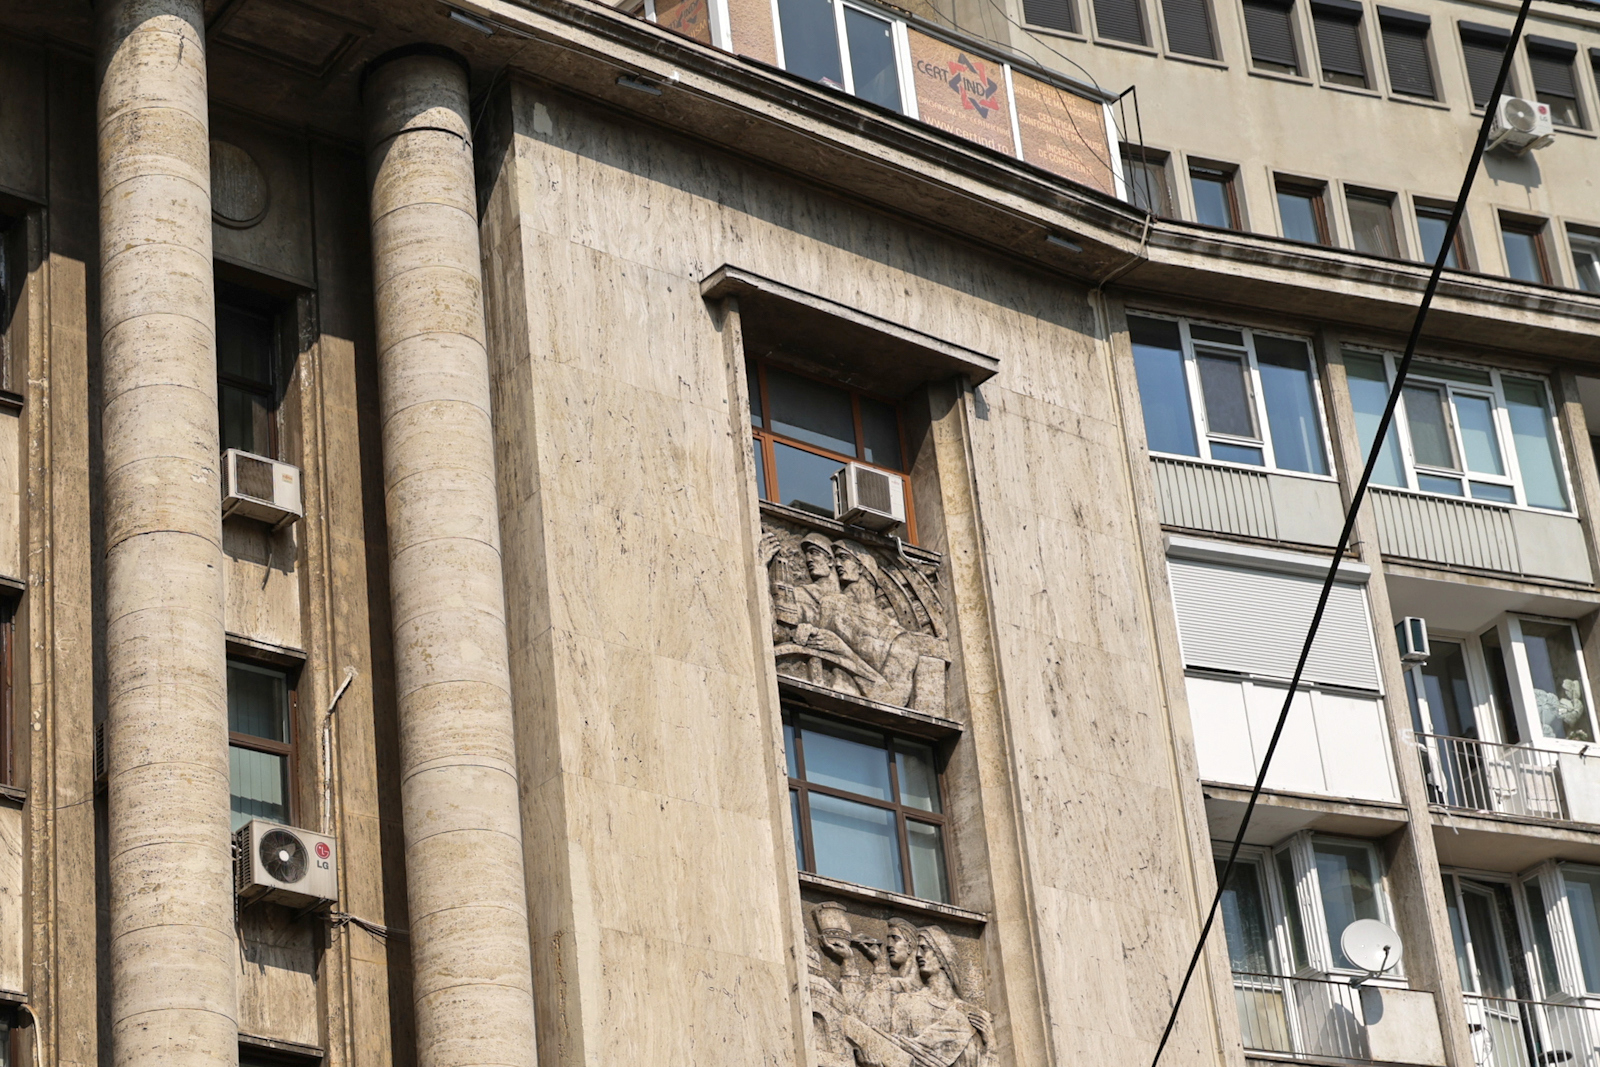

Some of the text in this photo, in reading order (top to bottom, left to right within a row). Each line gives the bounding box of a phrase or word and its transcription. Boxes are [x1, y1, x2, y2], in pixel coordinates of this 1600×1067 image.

[917, 60, 985, 97] CERT IND
[316, 860, 329, 870] LG
